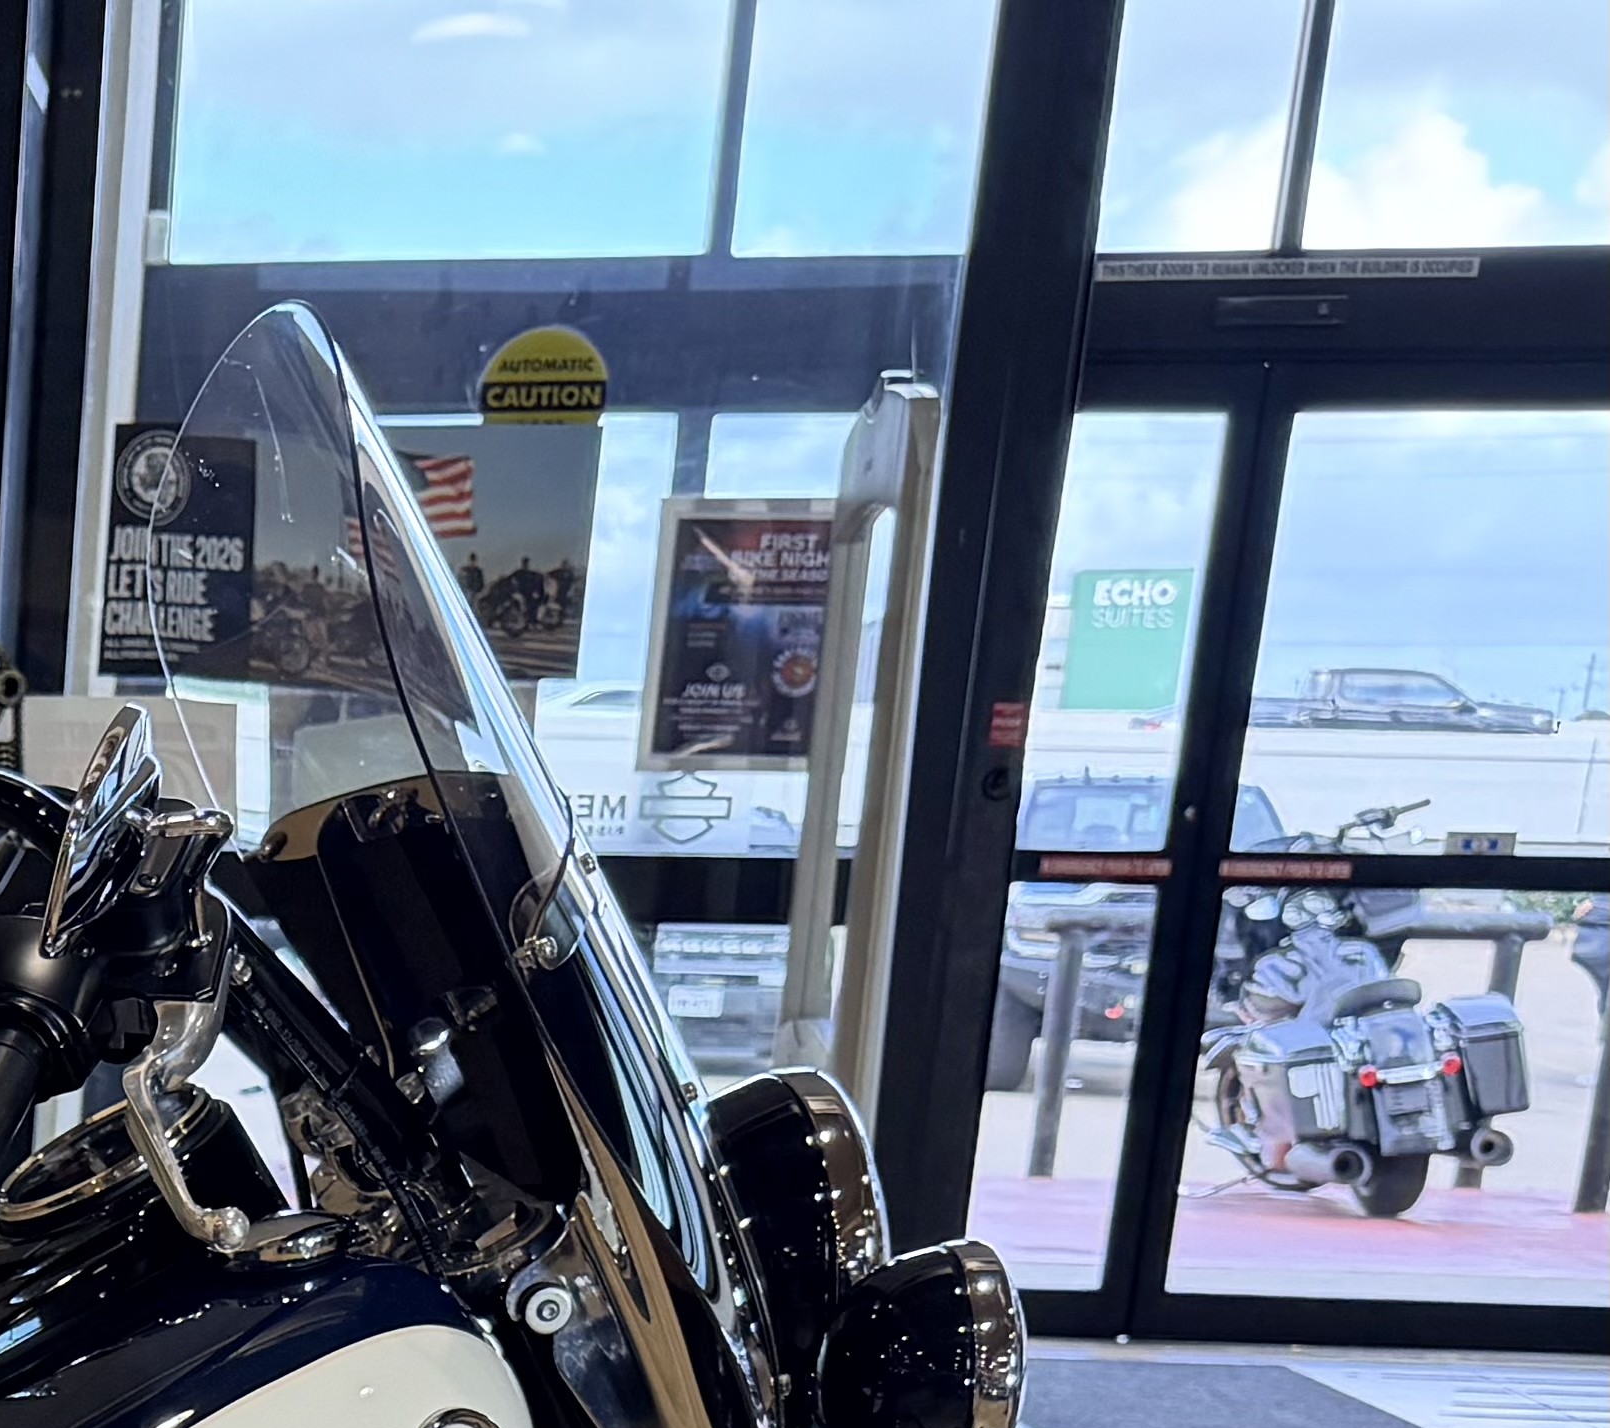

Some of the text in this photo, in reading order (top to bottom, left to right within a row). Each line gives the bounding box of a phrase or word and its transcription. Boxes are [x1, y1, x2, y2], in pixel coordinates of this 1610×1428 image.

[498, 357, 595, 373] AUTOMATIC
[486, 384, 602, 408] CAUTION
[110, 525, 245, 572] JOIN THE 2026
[760, 532, 819, 551] FIRST
[781, 550, 831, 568] NIGH
[107, 563, 209, 605] LETS RIDE
[1093, 579, 1178, 607] ECHO
[1091, 606, 1175, 629] SUITES
[682, 682, 720, 699] JOIN
